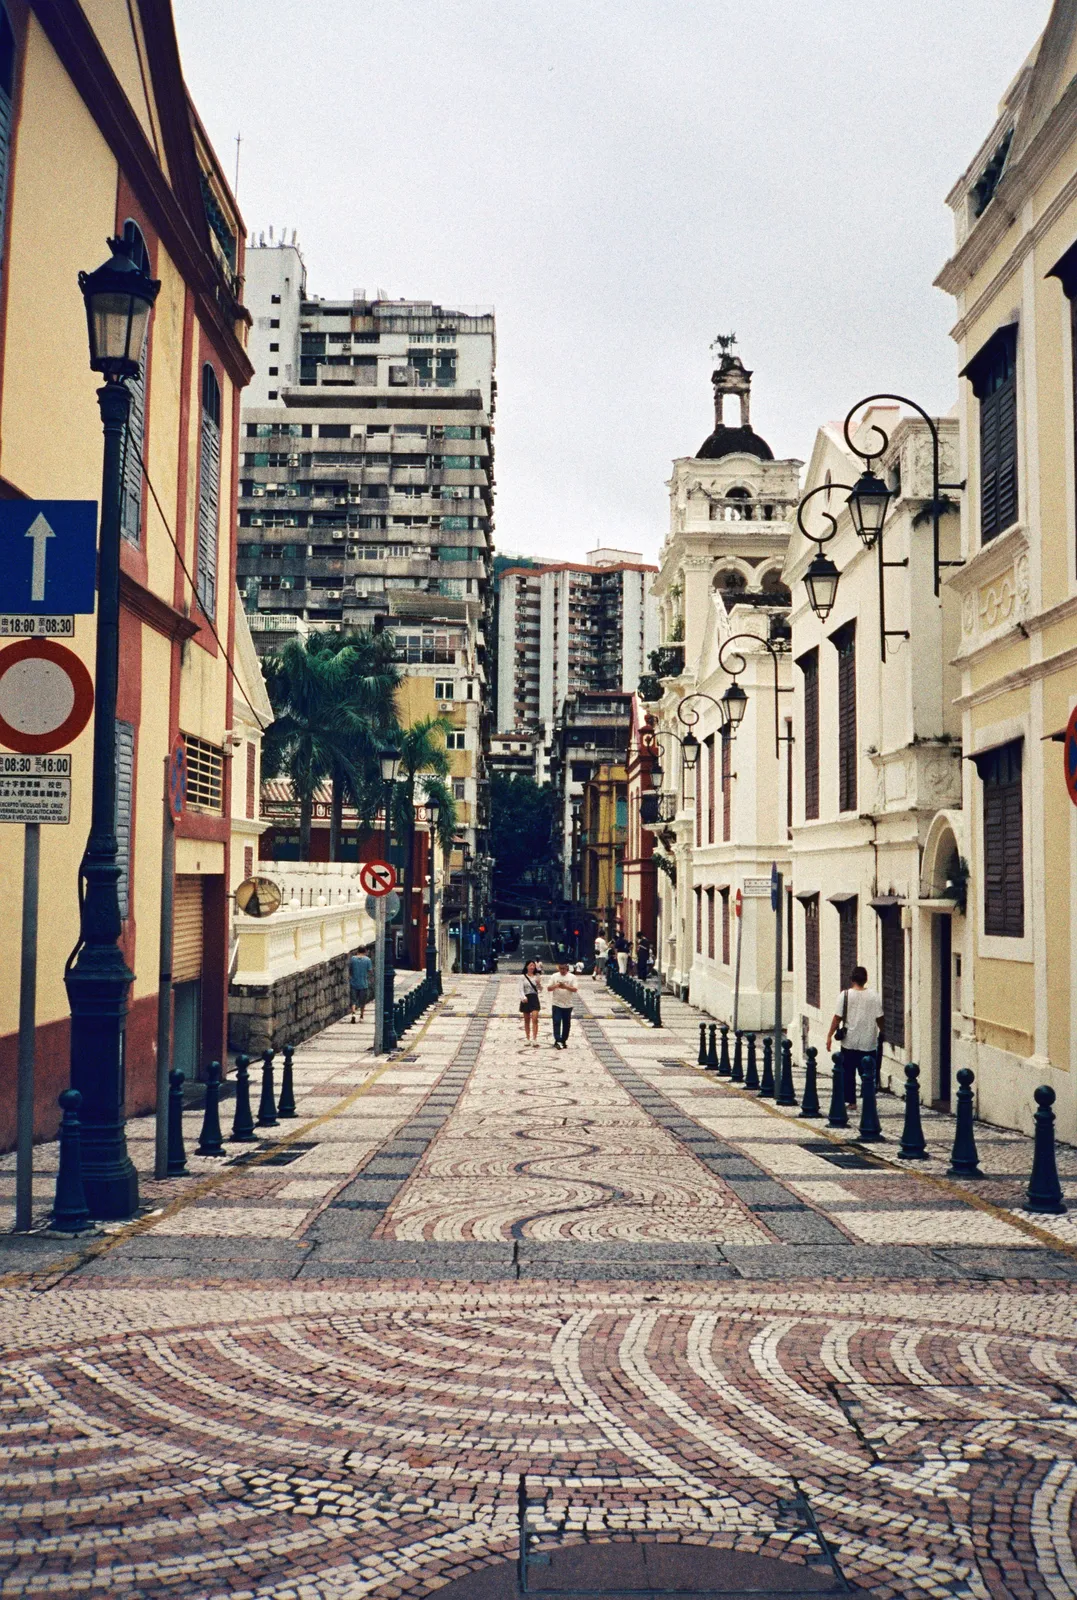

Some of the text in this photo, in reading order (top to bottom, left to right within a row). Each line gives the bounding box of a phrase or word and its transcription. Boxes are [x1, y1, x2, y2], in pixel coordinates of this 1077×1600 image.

[10, 618, 35, 633] 18:00
[46, 618, 71, 633] 08:30
[5, 757, 31, 772] 08:30
[42, 758, 68, 772] 18:00
